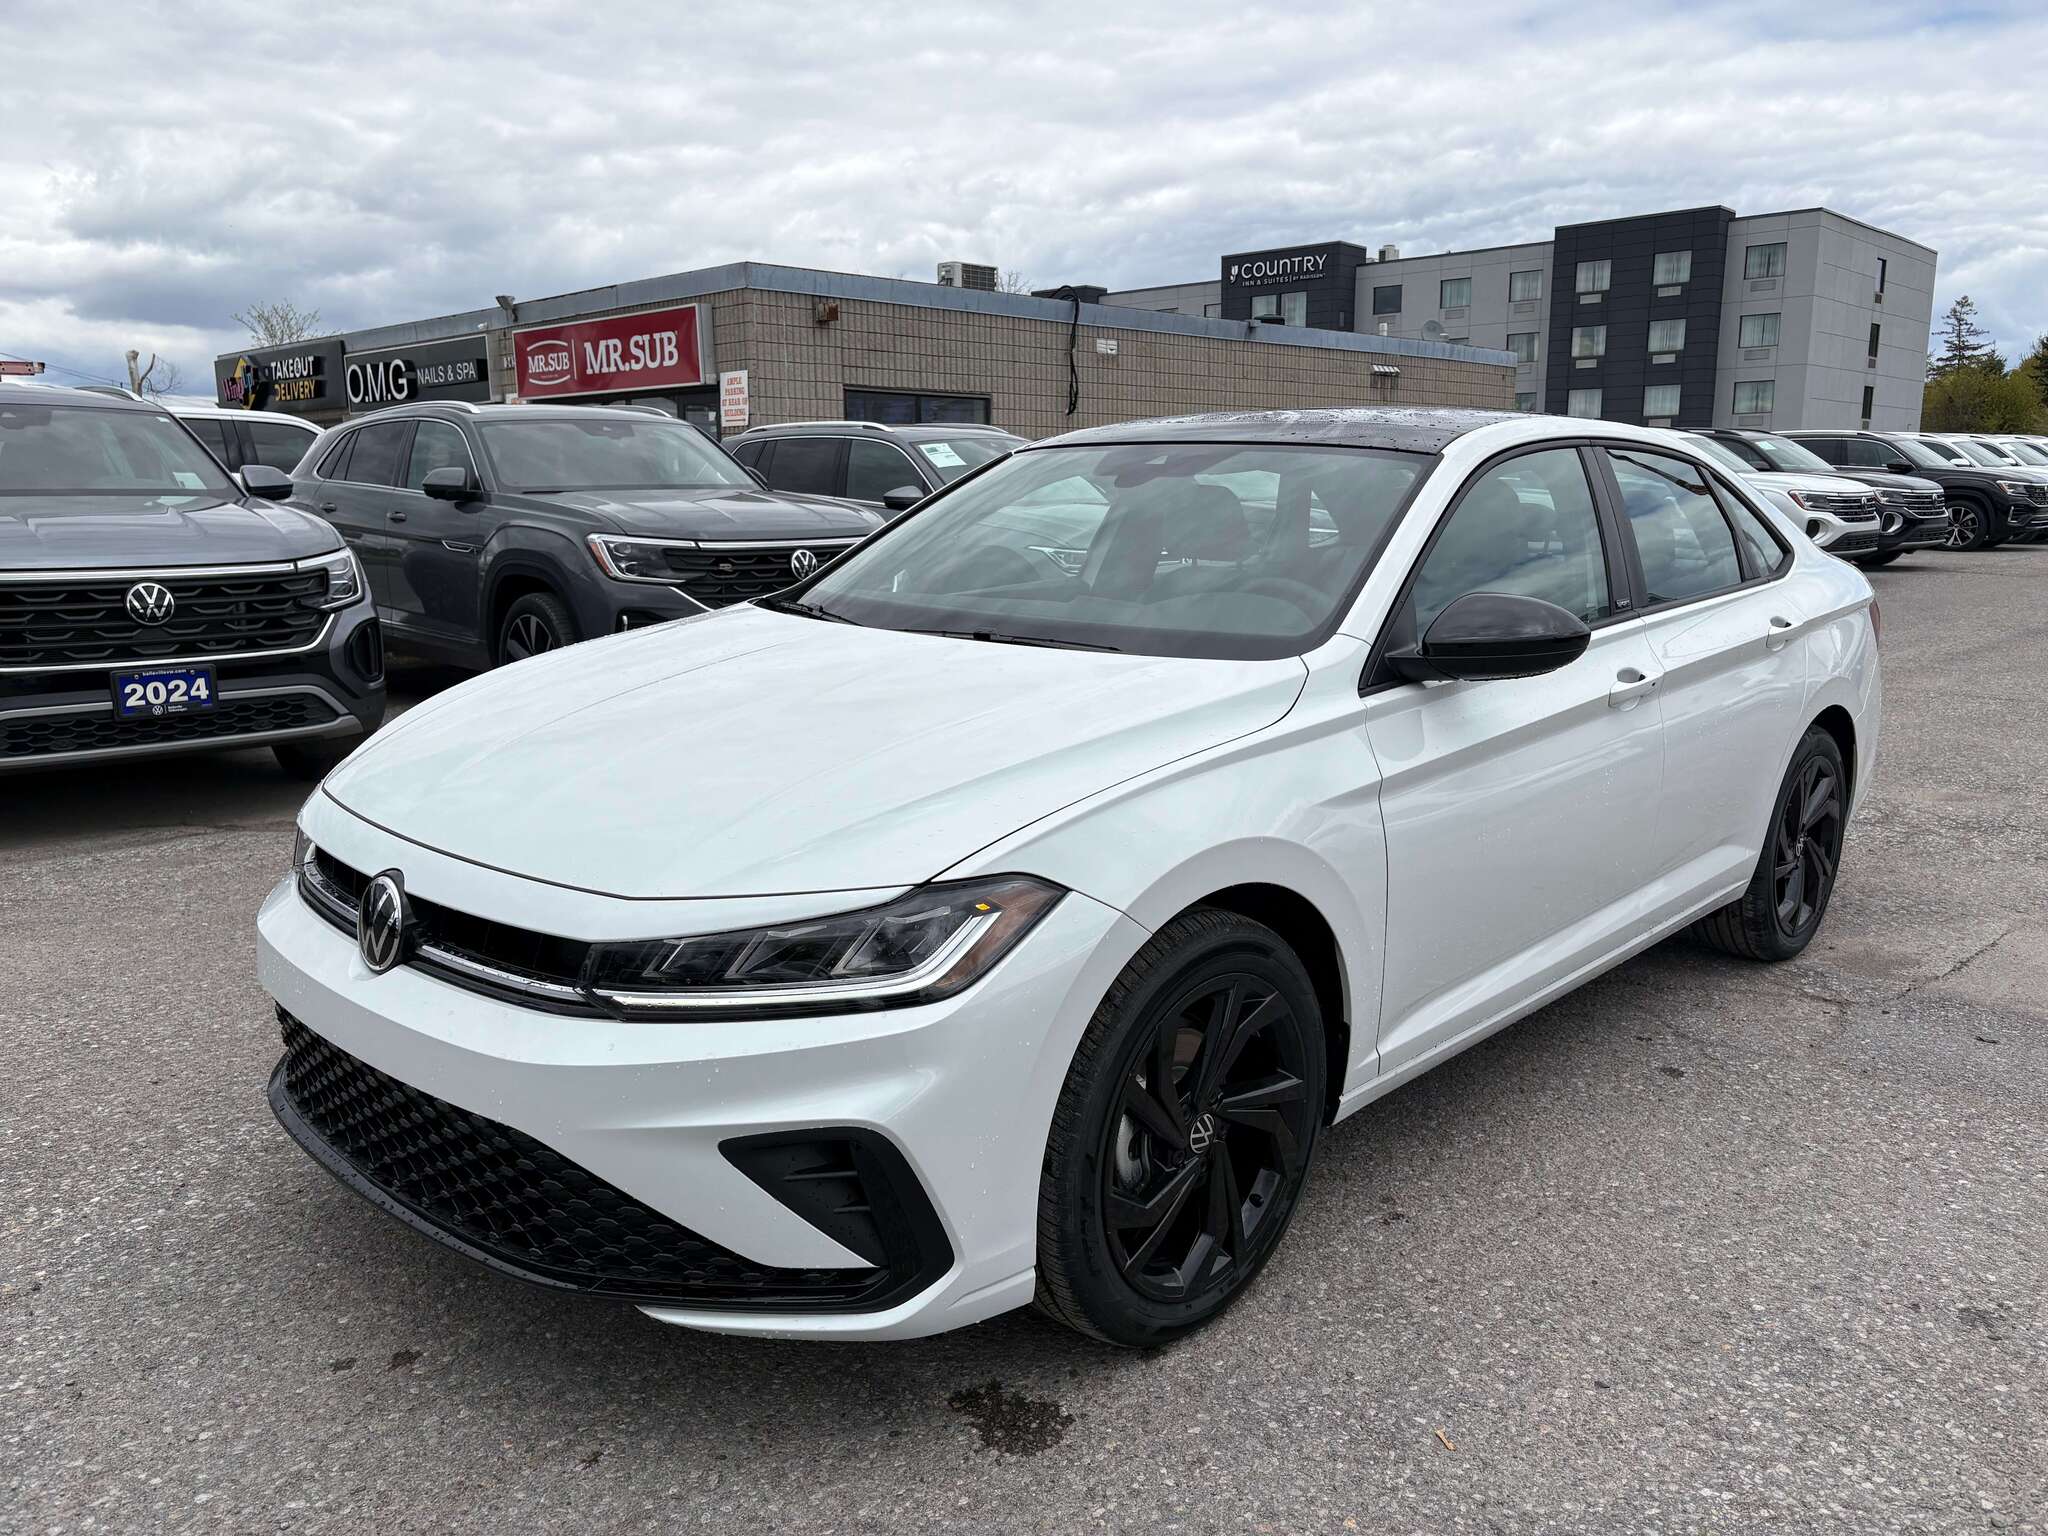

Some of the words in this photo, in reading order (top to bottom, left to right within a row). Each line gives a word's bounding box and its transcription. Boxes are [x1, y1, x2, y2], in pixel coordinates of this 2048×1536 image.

[1241, 254, 1327, 279] COUNTRY
[1263, 276, 1289, 285] SUITES
[528, 352, 570, 374] MR.SUB
[584, 331, 679, 375] MR.SUB
[270, 356, 314, 380] TAKEOUT
[417, 366, 445, 385] NAILS
[447, 364, 454, 381] &
[456, 362, 476, 381] SPA
[274, 380, 316, 401] DELIVERY
[124, 677, 209, 707] 2024
